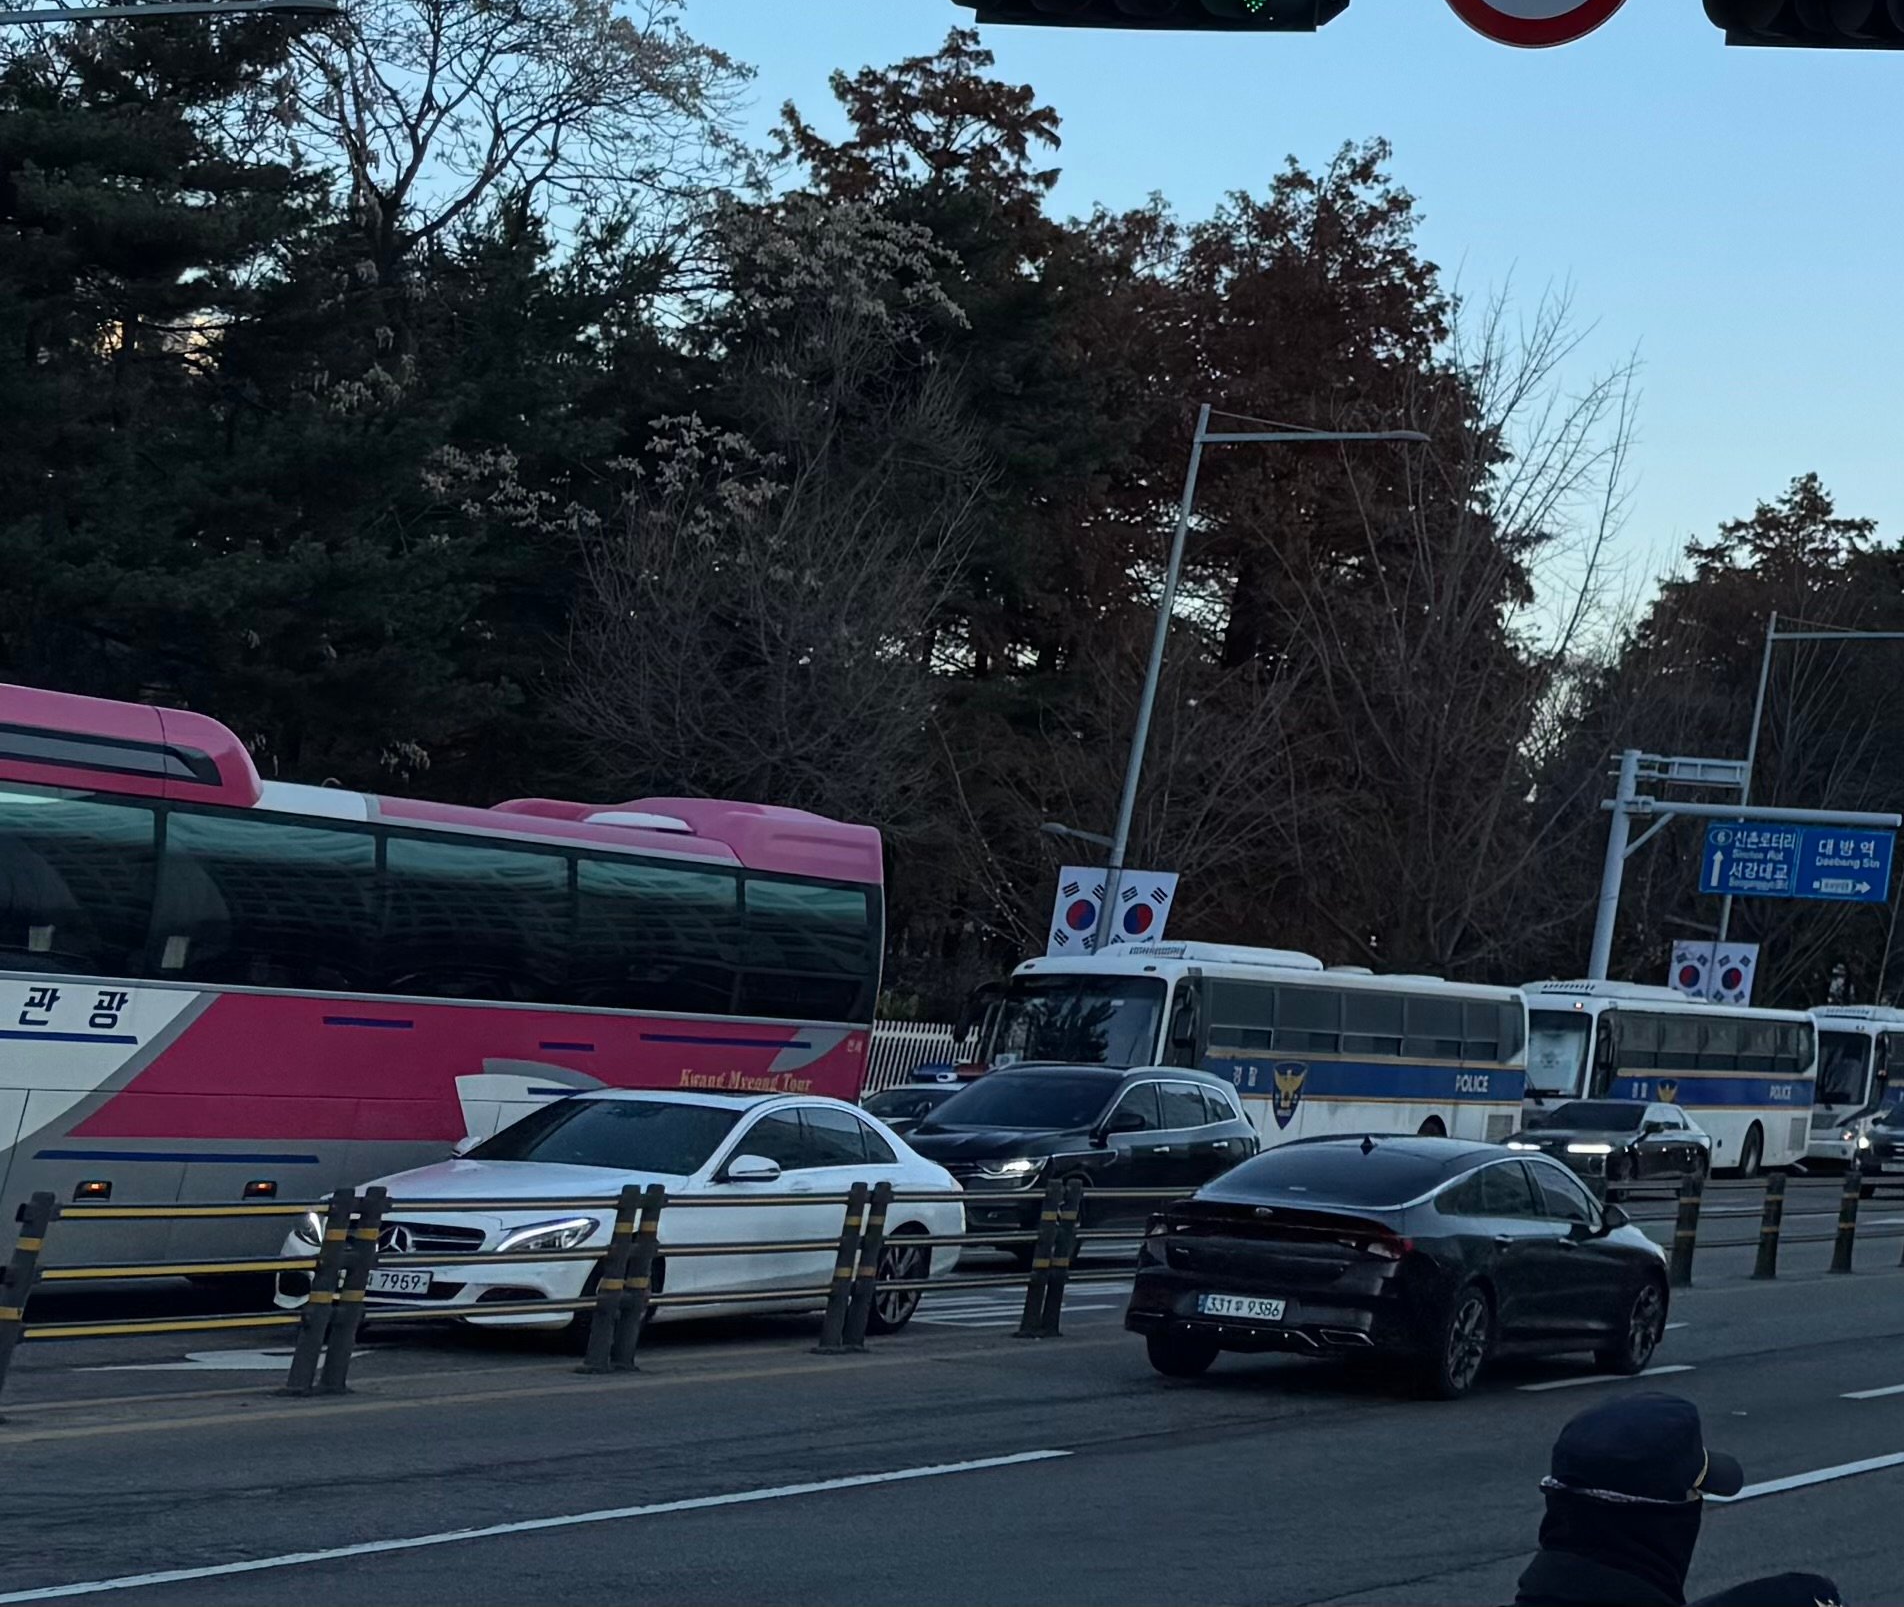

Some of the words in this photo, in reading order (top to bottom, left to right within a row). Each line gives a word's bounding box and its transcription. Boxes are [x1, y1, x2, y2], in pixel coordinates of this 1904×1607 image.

[1734, 830, 1796, 850] 신촌로터리
[1728, 861, 1789, 880] 서강대교
[18, 986, 129, 1030] 관광
[679, 1069, 725, 1088] Kwang
[783, 1073, 813, 1092] Tour
[1455, 1074, 1489, 1093] POLICE
